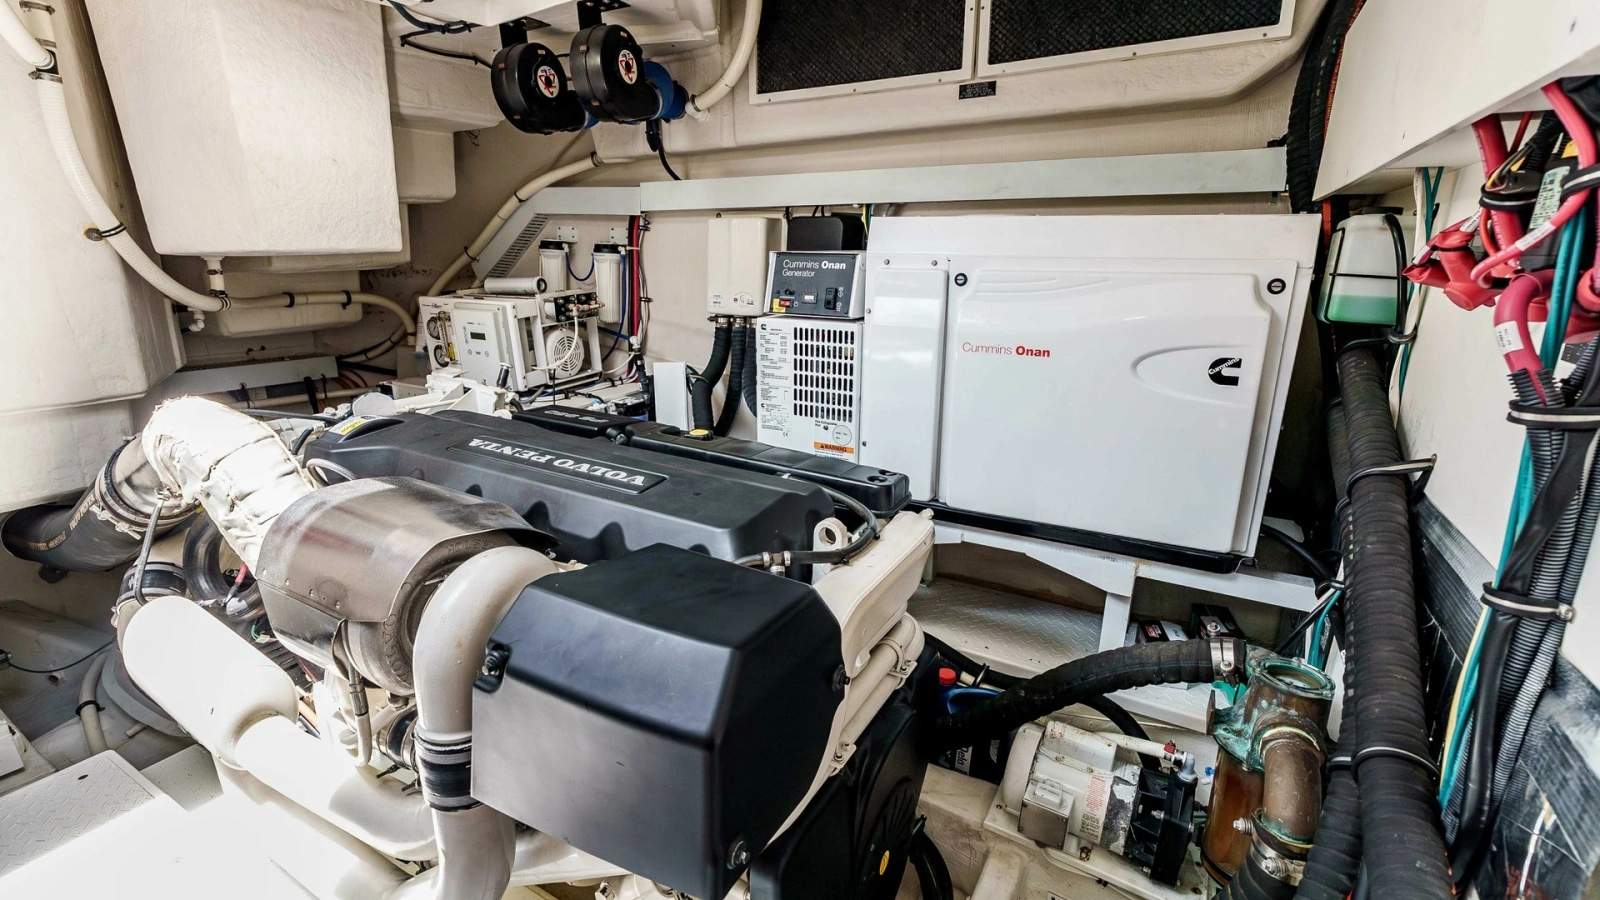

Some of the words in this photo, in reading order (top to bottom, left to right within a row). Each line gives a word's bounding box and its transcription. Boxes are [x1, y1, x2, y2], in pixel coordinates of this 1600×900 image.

[782, 268, 815, 277] Generator
[783, 259, 819, 269] Cummins
[821, 260, 846, 270] Onan
[962, 341, 1012, 355] Cummins
[1015, 345, 1050, 358] Onan
[1208, 358, 1240, 375] Cummins
[468, 438, 556, 463] PENTA
[824, 444, 847, 453] WARNING
[553, 458, 645, 486] VOLVO
[383, 613, 412, 687] VOLVO
